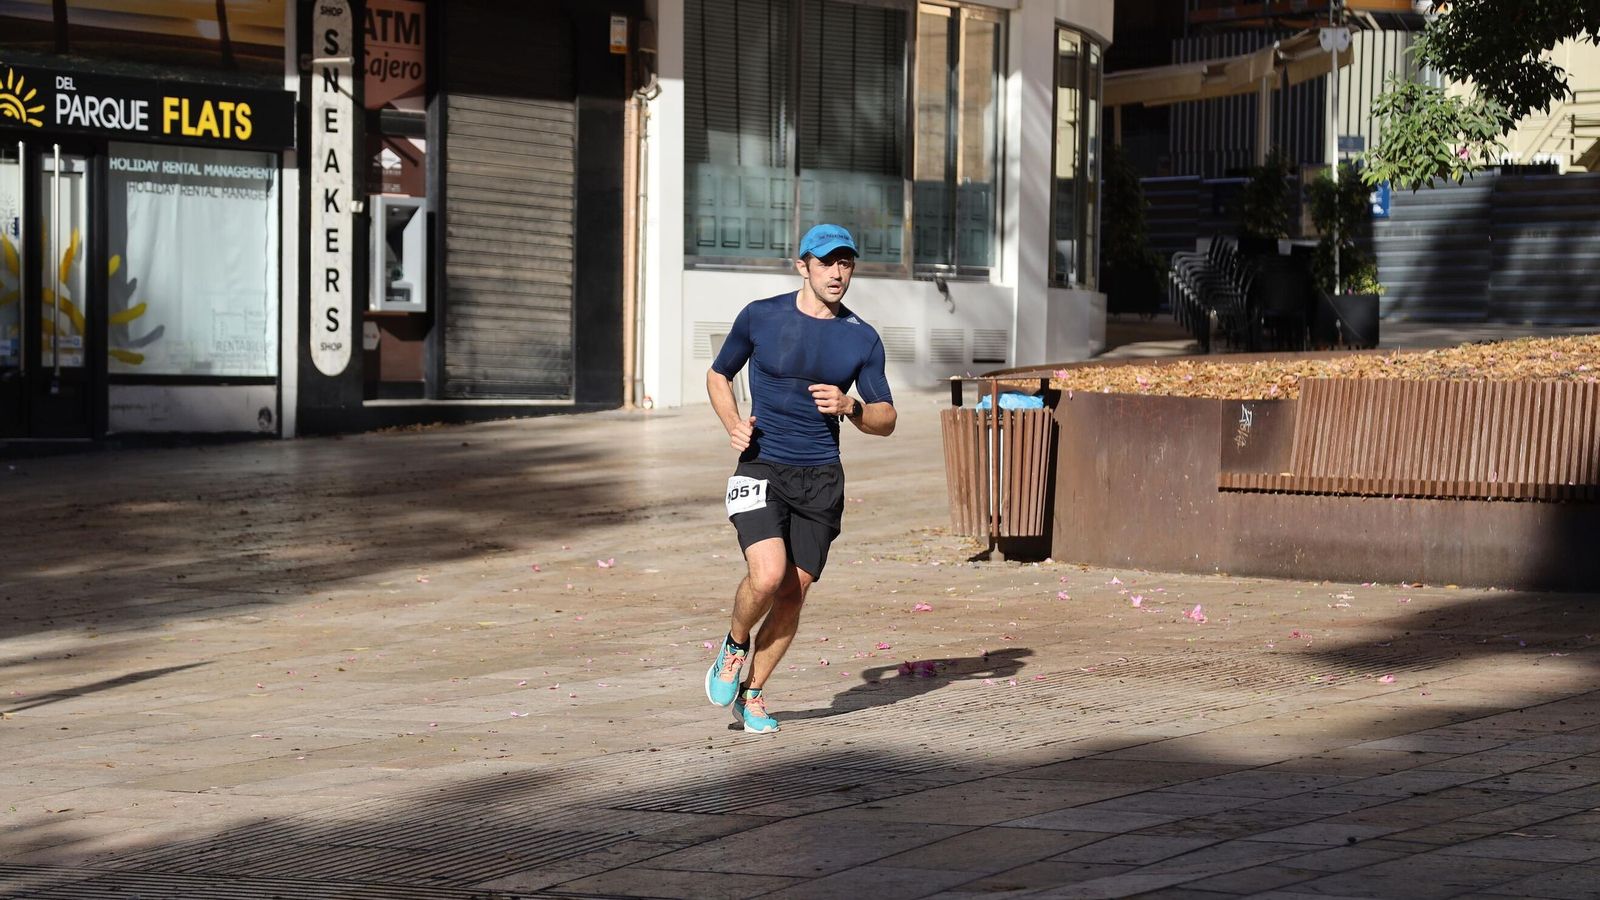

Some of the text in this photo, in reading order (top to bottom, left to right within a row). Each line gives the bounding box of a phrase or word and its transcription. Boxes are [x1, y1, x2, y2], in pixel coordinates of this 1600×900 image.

[320, 6, 343, 17] SHOP
[364, 8, 421, 46] ATM
[55, 75, 77, 91] DEL
[55, 92, 253, 141] PARQUE FLATS
[109, 157, 274, 180] HOLIDAY RENTAL MANAGEMENT
[323, 28, 341, 333] SNEAKERS
[320, 342, 343, 352] SHOP
